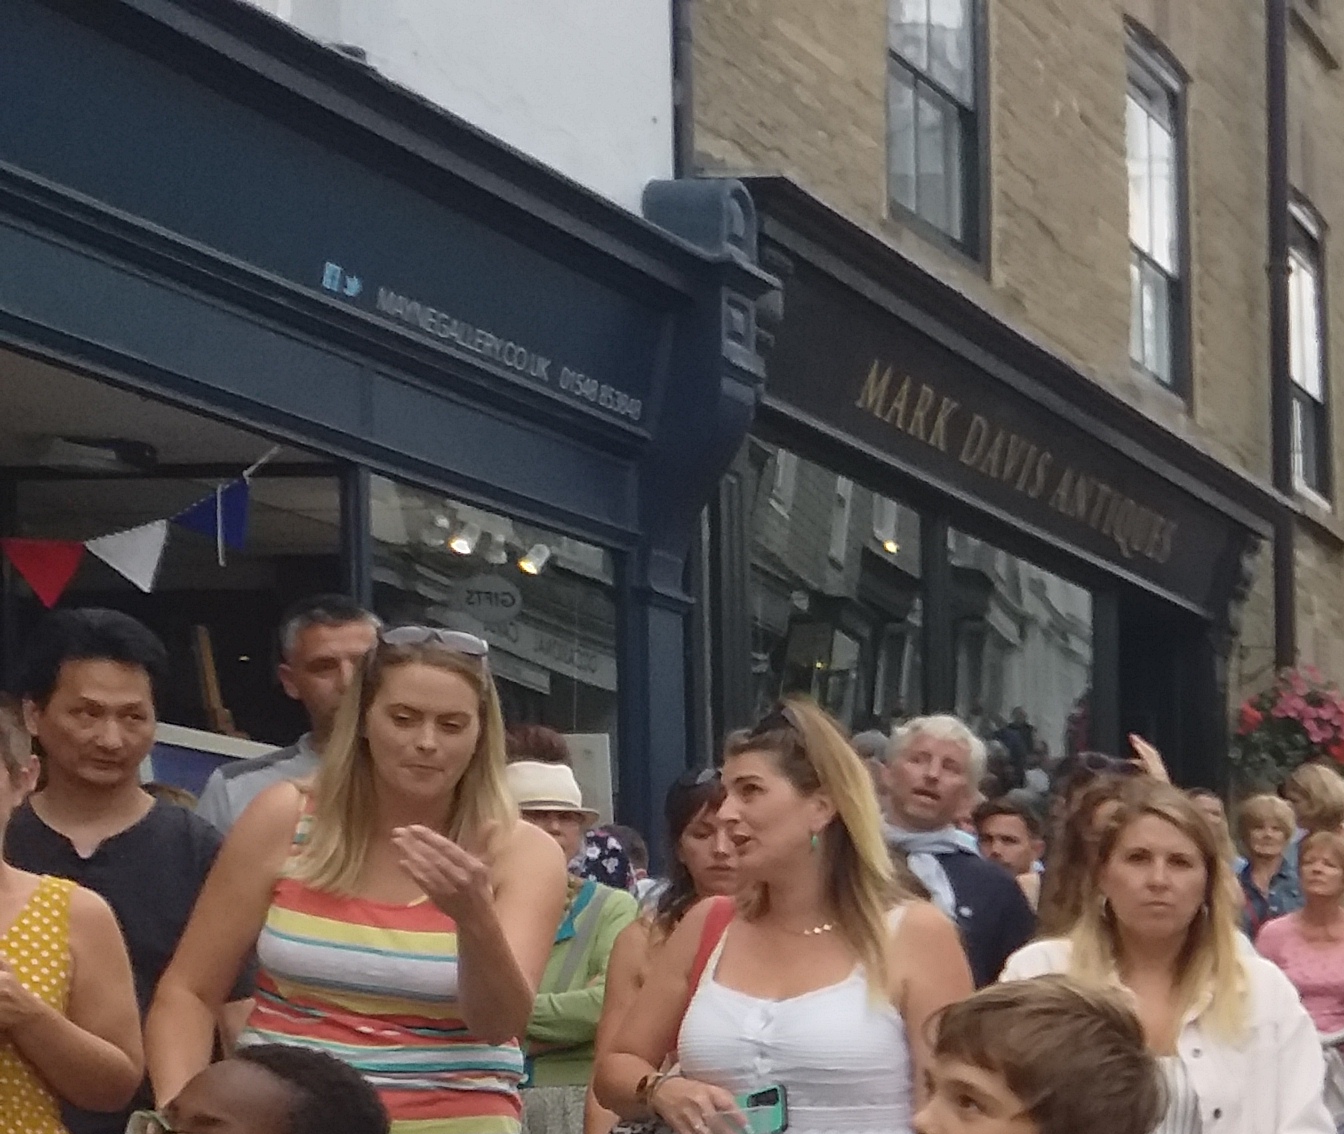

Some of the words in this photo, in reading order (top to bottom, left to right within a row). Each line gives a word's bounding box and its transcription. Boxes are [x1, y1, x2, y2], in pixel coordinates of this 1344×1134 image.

[855, 358, 960, 452] MARK
[958, 411, 1053, 499] DAVIS
[1048, 465, 1179, 564] ANTIQUES
